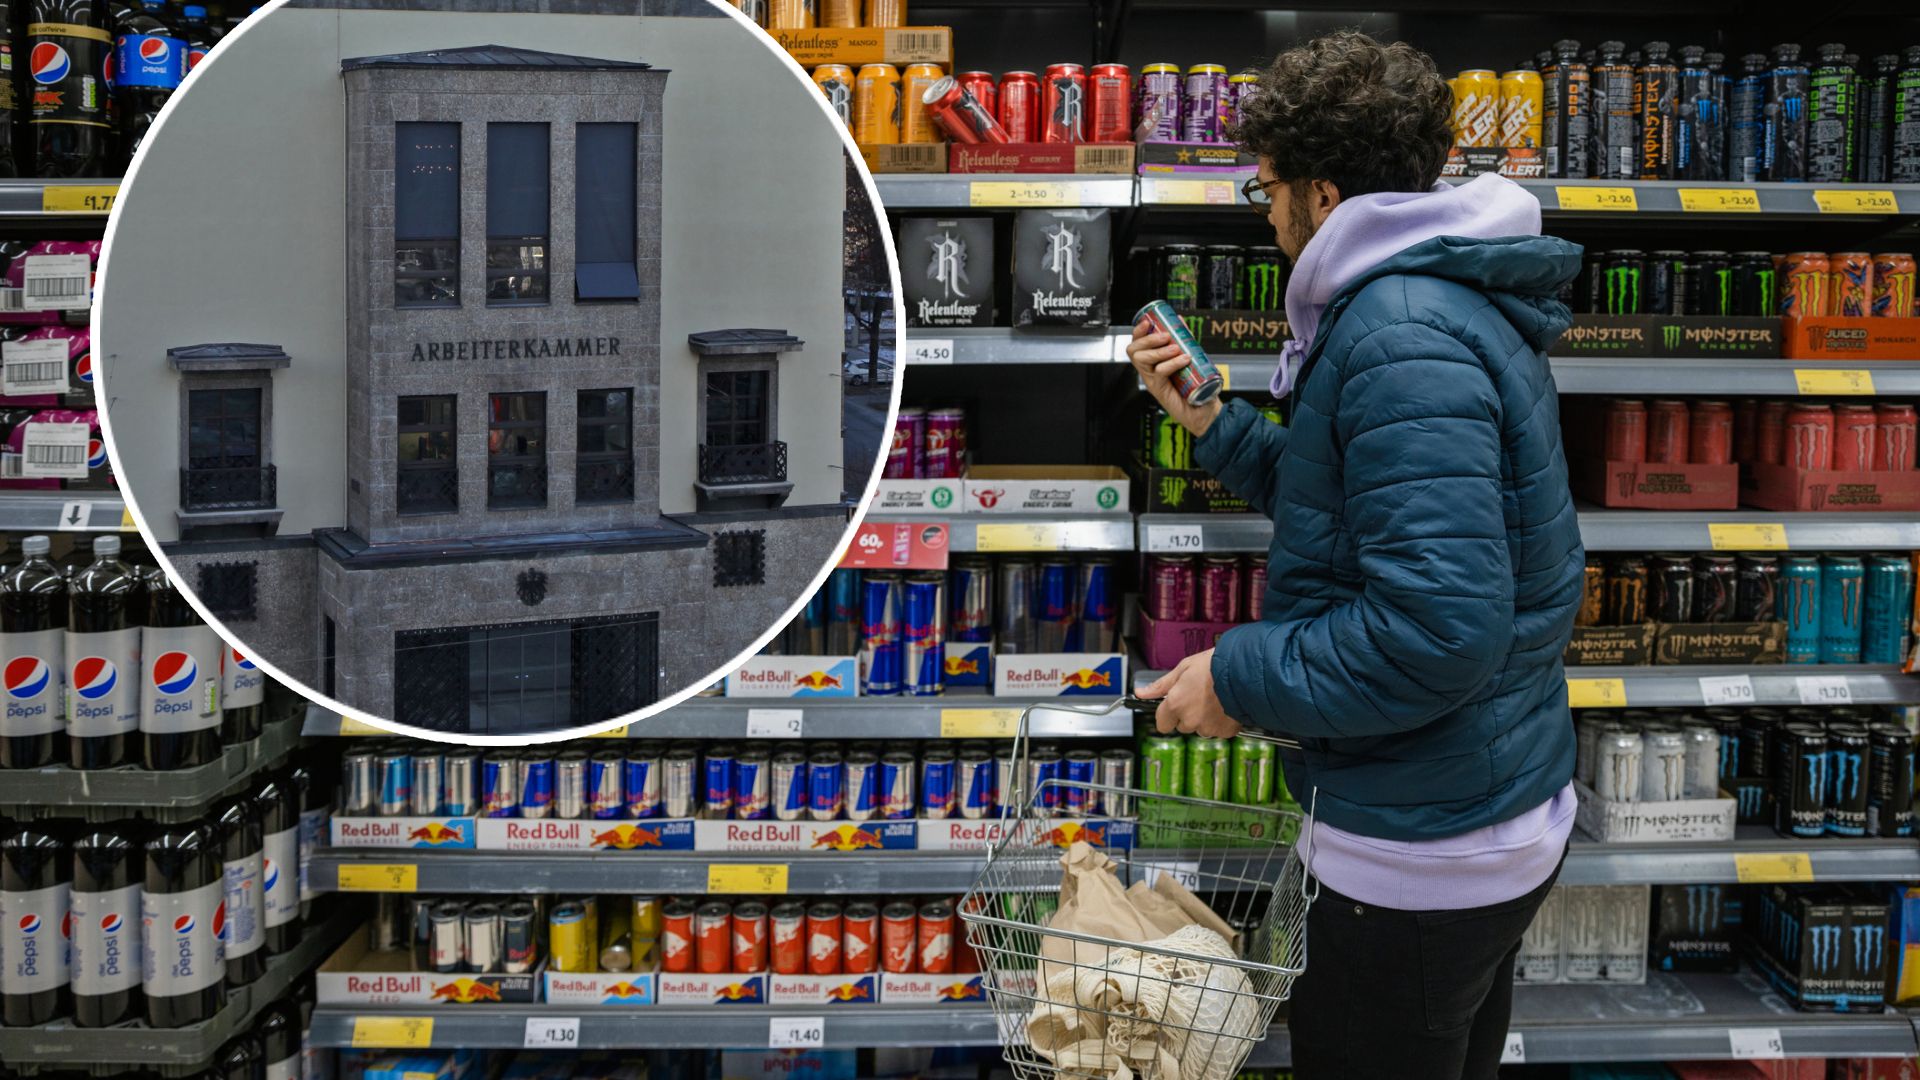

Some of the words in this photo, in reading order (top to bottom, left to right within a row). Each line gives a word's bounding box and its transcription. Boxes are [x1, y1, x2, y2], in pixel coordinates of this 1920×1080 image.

[778, 32, 840, 51] Relentless
[848, 39, 878, 47] MANGO
[142, 65, 168, 74] pepsi
[958, 148, 1020, 173] Relentless
[1029, 155, 1062, 164] CHERRY
[1498, 164, 1545, 176] ALERT
[1031, 288, 1093, 316] Relentless
[918, 297, 979, 325] Relentless
[1211, 317, 1290, 339] MONST
[1560, 326, 1644, 342] MONSTER
[1685, 327, 1773, 343] MONSTER
[1825, 328, 1868, 339] JUICED
[411, 336, 622, 363] ARBEITERKAMMER
[1231, 341, 1278, 349] ENER
[915, 347, 950, 360] £4.50
[859, 533, 884, 548] 60p
[1170, 535, 1201, 547] £1.70
[1569, 638, 1637, 651] MONSTER
[1688, 634, 1763, 648] MONSTER
[1580, 651, 1625, 659] MULE
[740, 670, 764, 684] Red
[767, 670, 791, 684] Bull
[1007, 669, 1032, 682] Red
[1034, 669, 1058, 682] Bull
[1722, 685, 1750, 698] £1.70
[1818, 687, 1848, 698] £1.70
[6, 704, 46, 718] pepsi
[76, 704, 114, 719] pepsi
[154, 700, 193, 714] pepsi
[787, 719, 800, 733] £2
[1643, 814, 1723, 827] MONSTER
[341, 823, 370, 837] Red
[372, 823, 399, 836] Bull
[507, 823, 542, 839] Red
[546, 823, 580, 840] Bull
[727, 825, 763, 841] Red
[766, 825, 800, 841] Bull
[950, 823, 986, 840] Red
[24, 936, 39, 977] pepsi
[106, 935, 121, 976] pepsi
[176, 937, 194, 977] pepsi
[348, 976, 384, 993] Red
[387, 976, 421, 993] Bull
[552, 980, 574, 992] Red
[575, 980, 597, 992] Bull
[663, 982, 685, 993] Red
[687, 982, 709, 993] Bull
[774, 983, 796, 994] Red
[798, 983, 820, 994] Bull
[886, 982, 908, 993] Red
[910, 982, 932, 993] Bull
[546, 1028, 575, 1042] £1.30
[790, 1028, 820, 1043] £1.40
